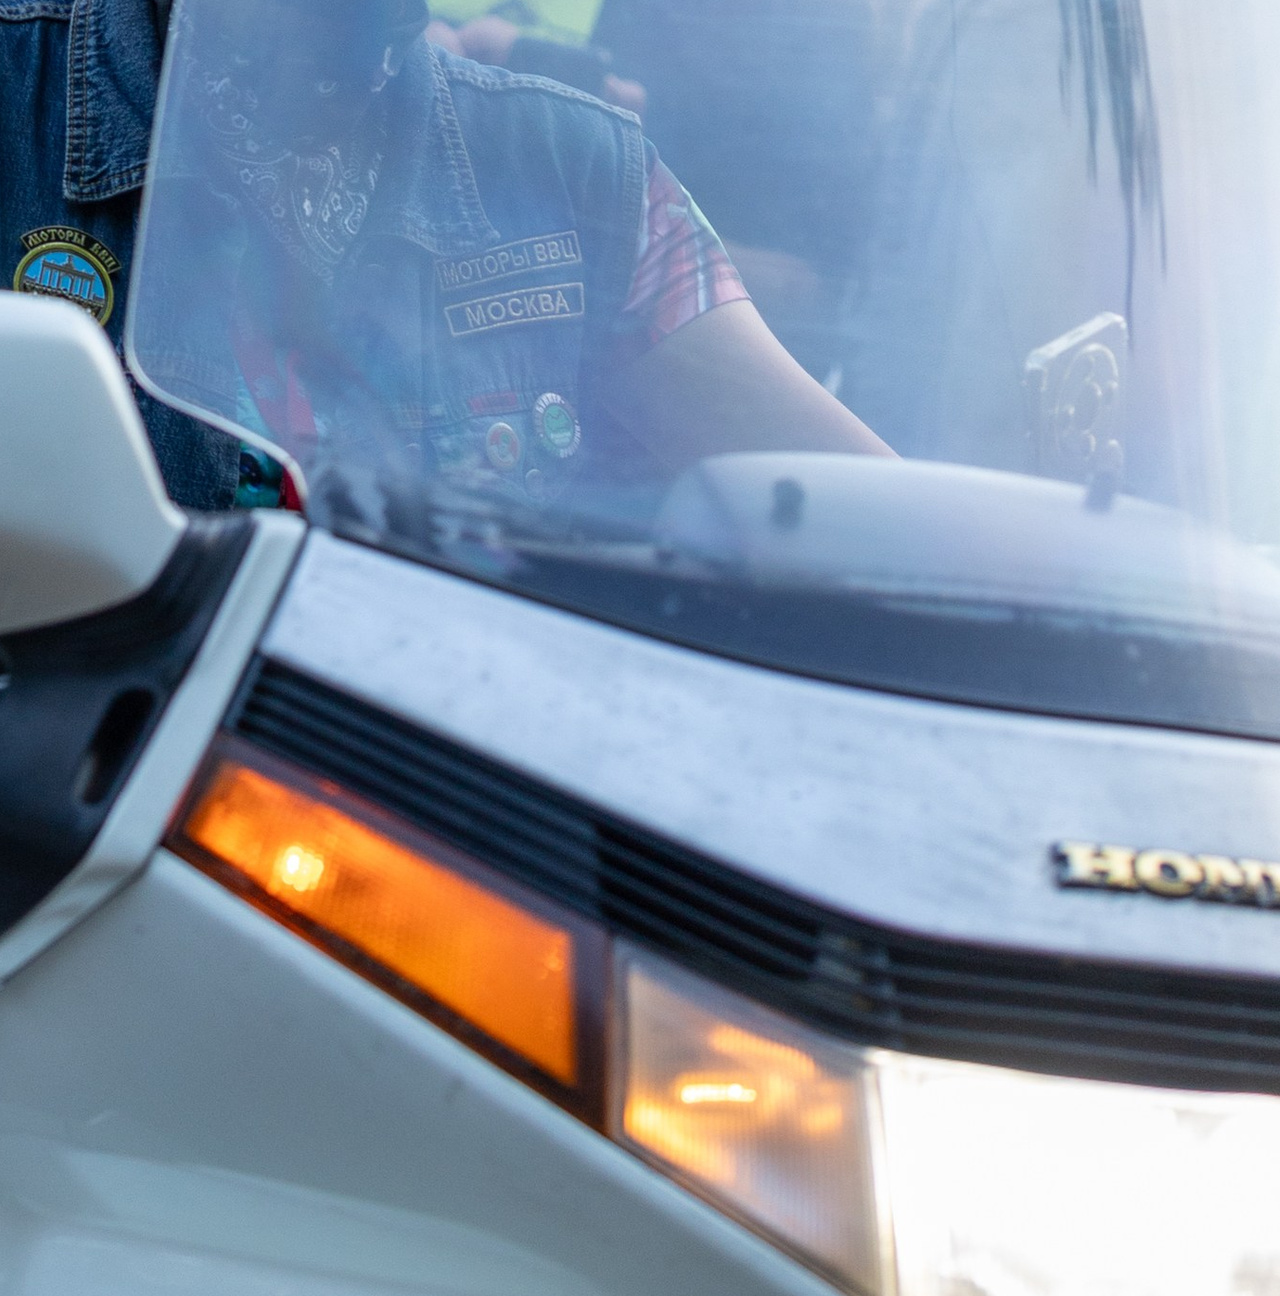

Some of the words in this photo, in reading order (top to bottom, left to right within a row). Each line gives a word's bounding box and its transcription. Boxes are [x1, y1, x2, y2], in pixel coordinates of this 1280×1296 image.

[27, 227, 88, 248] МОТОРЫ
[442, 248, 531, 285] МОТОРЫ
[532, 238, 578, 263] ВВЦ
[464, 289, 570, 329] МОСКВА
[1053, 840, 1280, 910] HON
